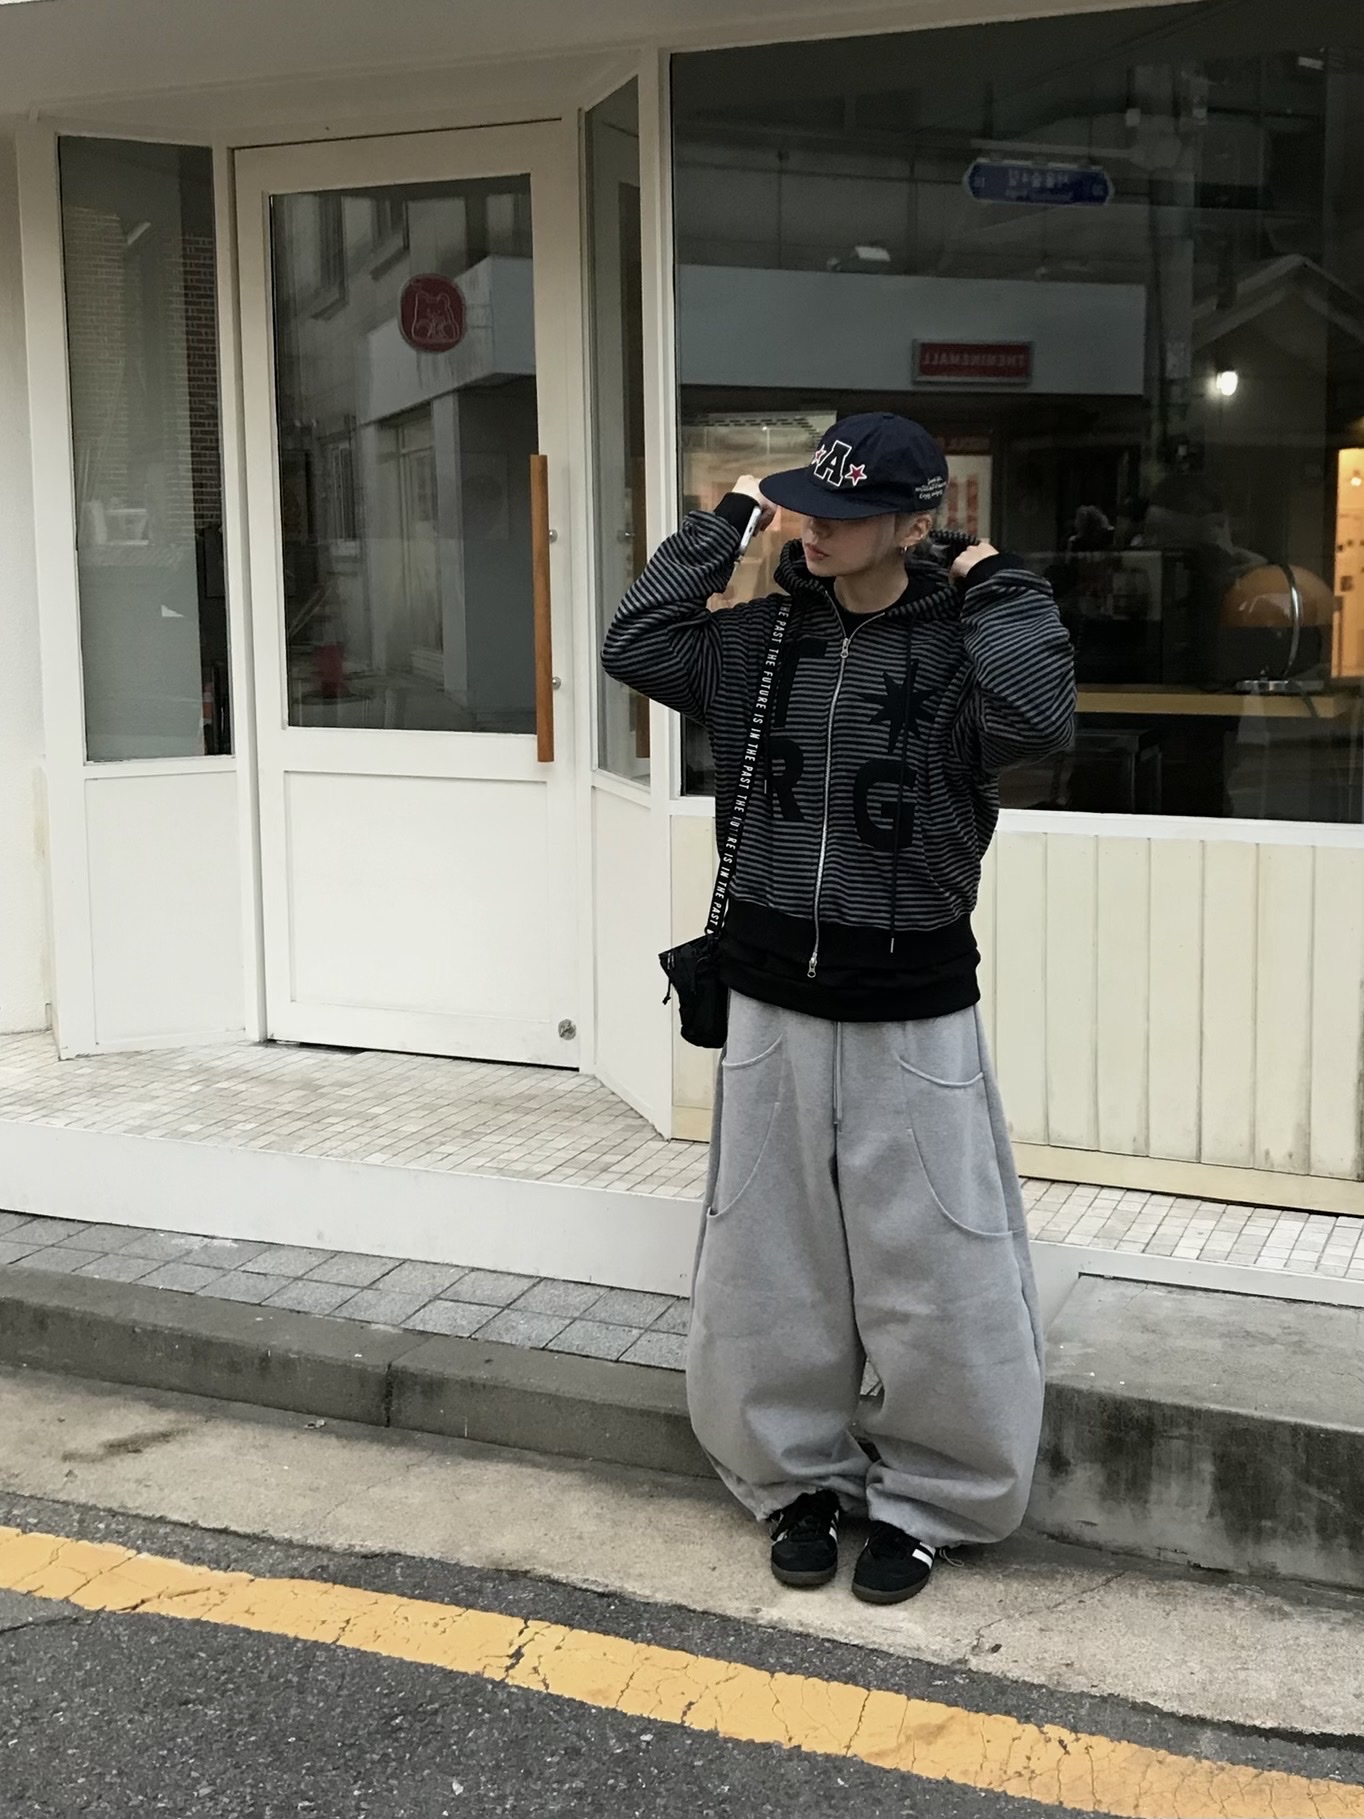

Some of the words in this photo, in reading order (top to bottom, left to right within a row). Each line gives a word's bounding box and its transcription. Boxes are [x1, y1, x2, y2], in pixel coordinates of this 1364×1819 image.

[813, 439, 853, 487] A
[771, 620, 787, 643] PAST
[765, 648, 779, 667] THE
[755, 670, 773, 710] FUTURE
[753, 715, 765, 724] IS
[749, 728, 761, 740] IN
[744, 743, 759, 762] THE
[738, 764, 754, 789] PAST
[733, 794, 747, 813] THE
[722, 852, 734, 864] IS
[719, 866, 731, 878] IN
[714, 880, 727, 900] THE
[708, 902, 722, 927] PAST
